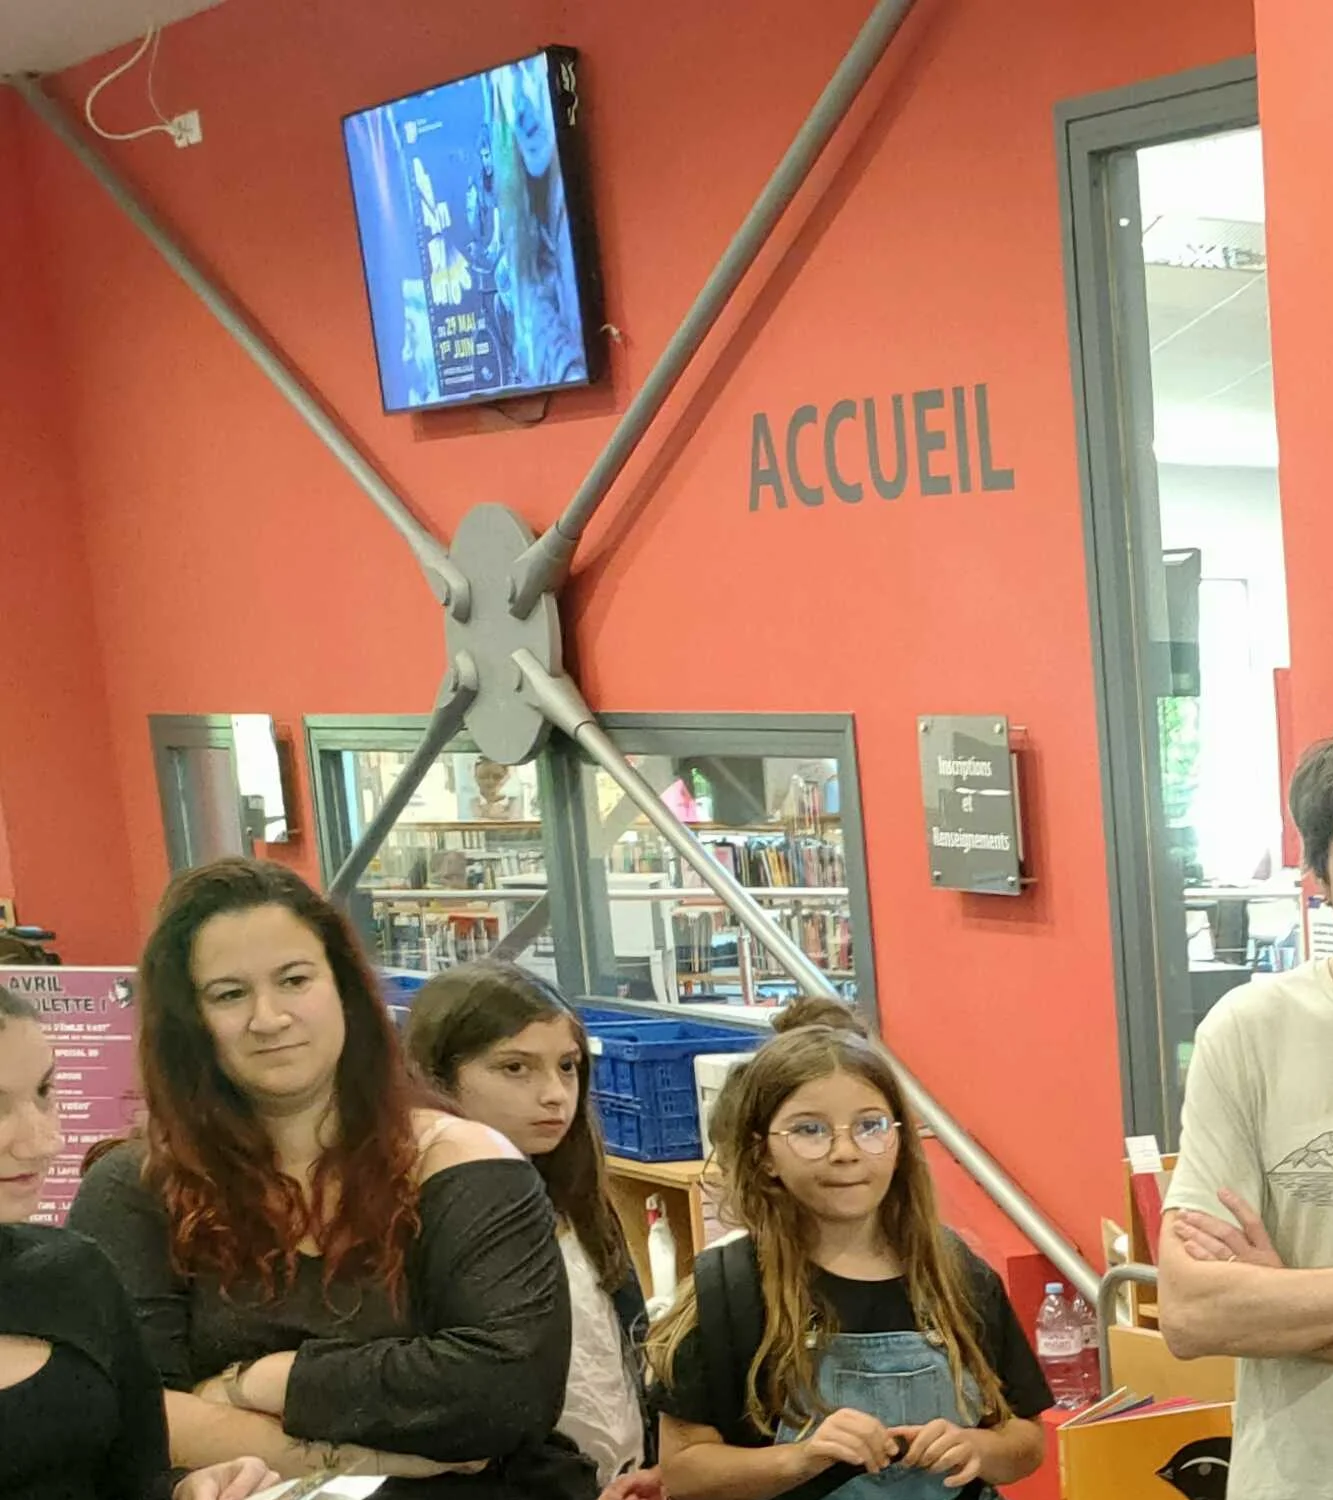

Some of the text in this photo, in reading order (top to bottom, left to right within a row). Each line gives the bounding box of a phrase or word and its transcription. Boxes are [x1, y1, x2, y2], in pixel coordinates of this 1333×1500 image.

[749, 383, 1015, 512] ACCUEIL
[938, 755, 992, 781] Inscriptions
[961, 794, 973, 812] et
[932, 826, 1010, 854] Renseignements
[9, 976, 63, 993] AVRIL
[38, 998, 94, 1012] LETTE
